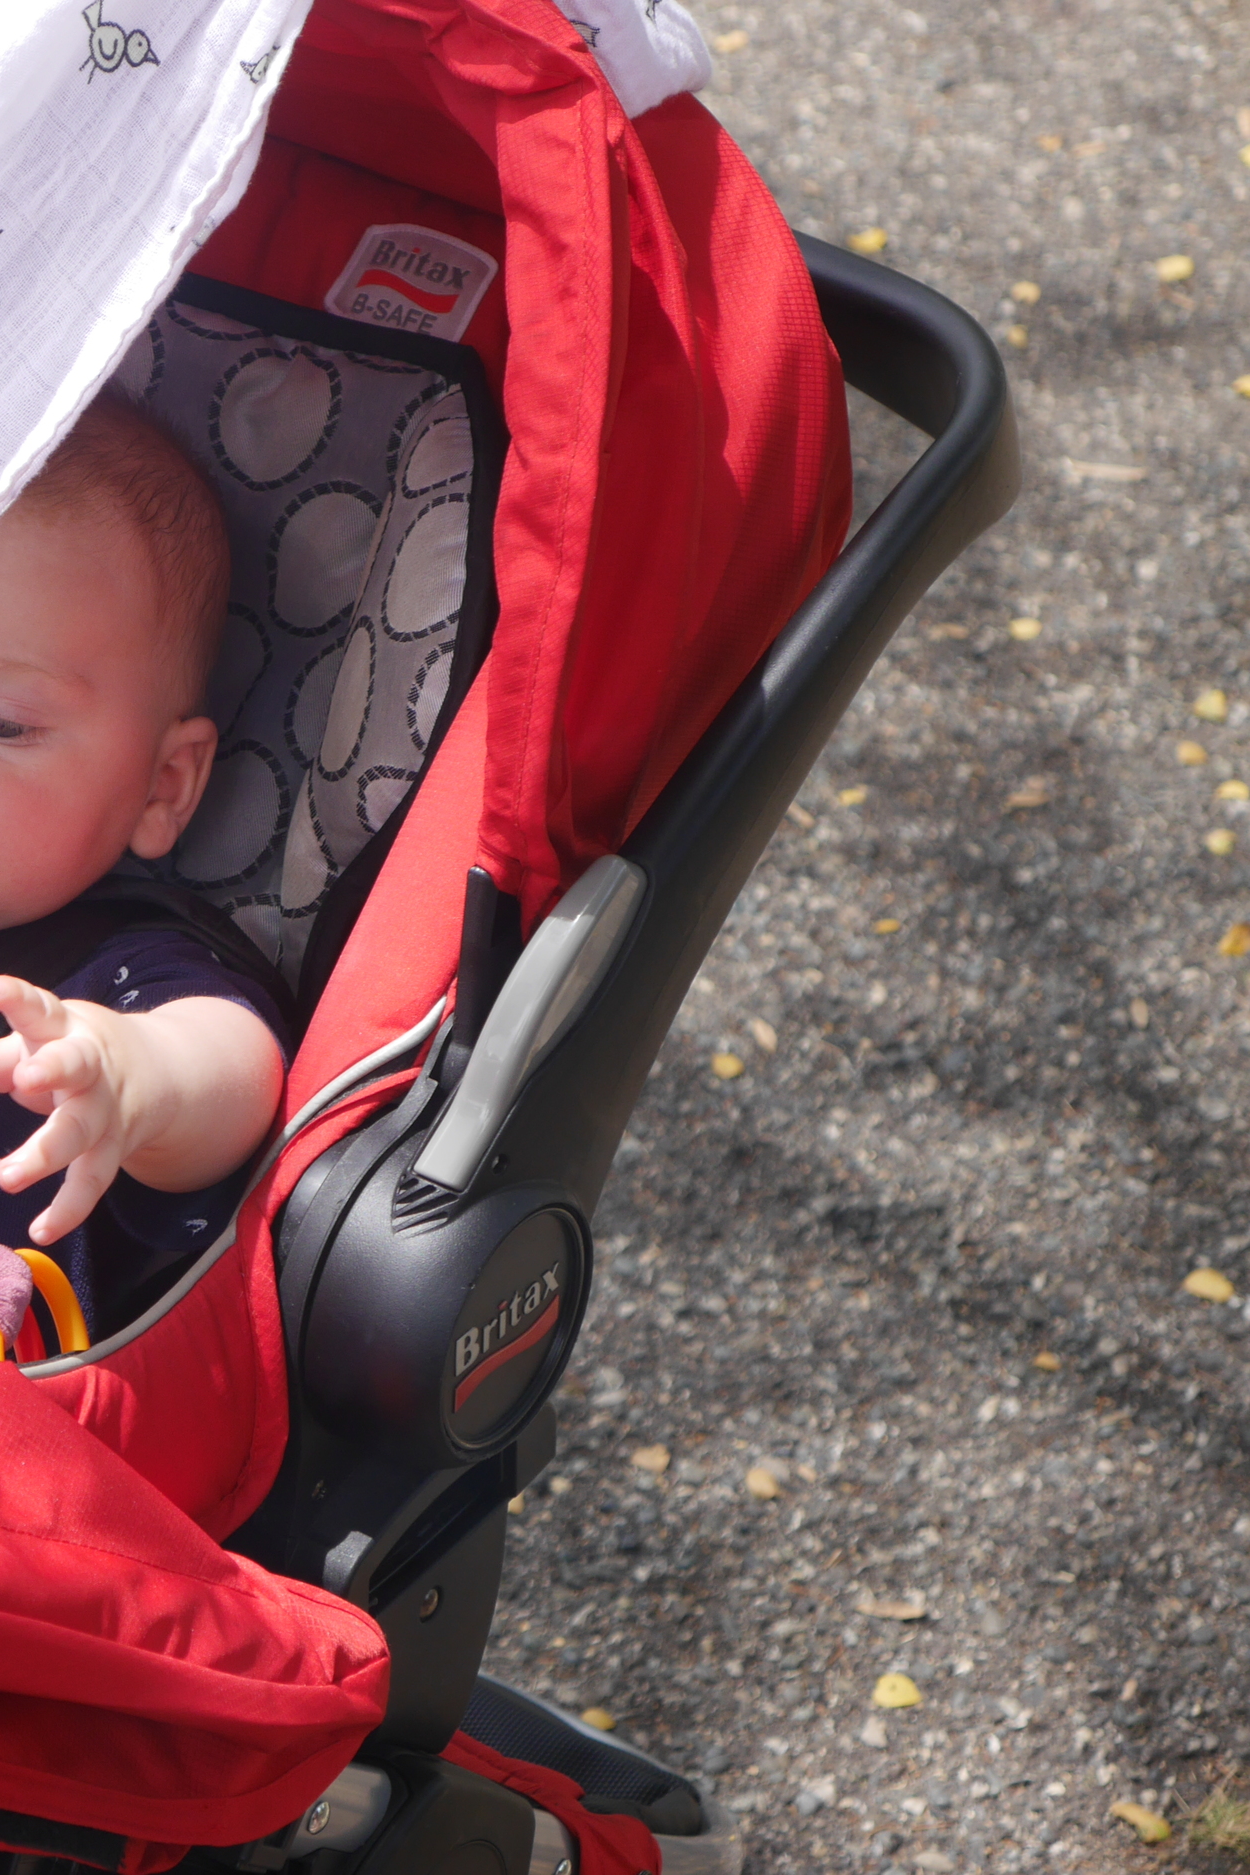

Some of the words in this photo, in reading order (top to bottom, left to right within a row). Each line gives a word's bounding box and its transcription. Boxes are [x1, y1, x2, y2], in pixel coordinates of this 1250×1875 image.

[370, 240, 471, 289] Britax
[351, 293, 438, 335] B-SAFE
[454, 1261, 560, 1378] Britax
